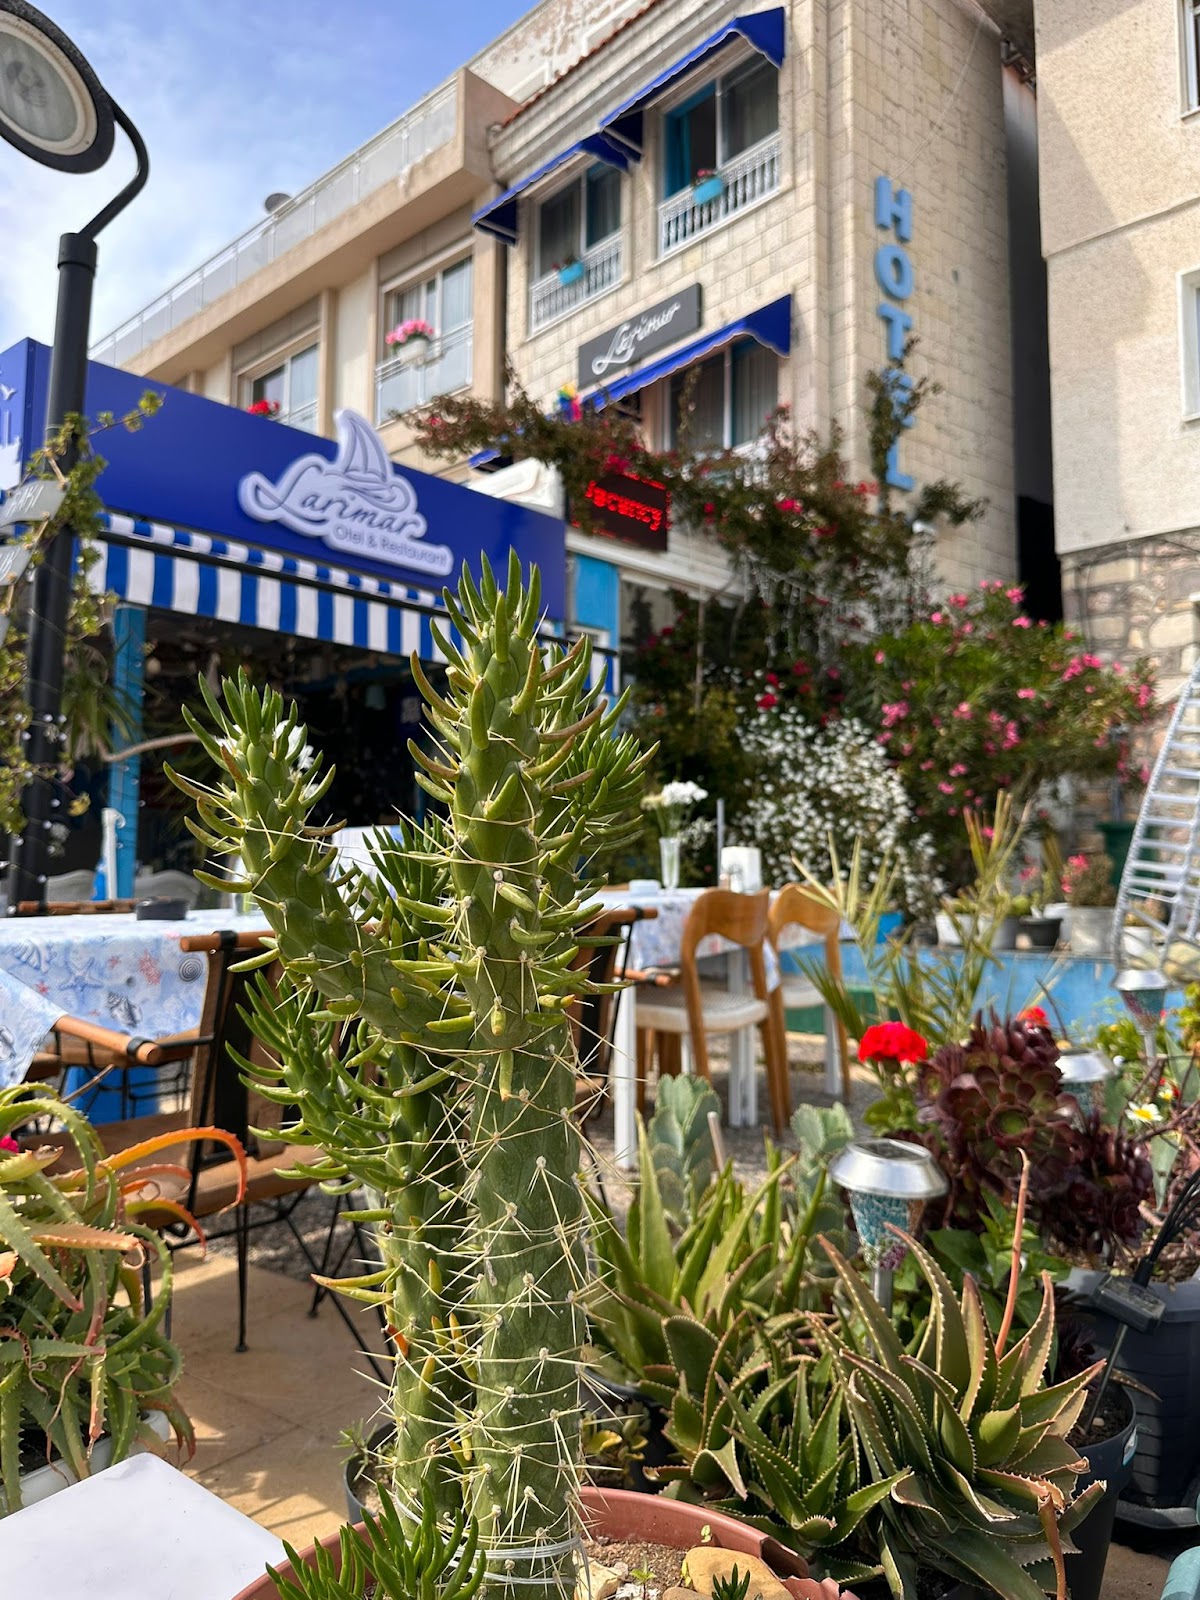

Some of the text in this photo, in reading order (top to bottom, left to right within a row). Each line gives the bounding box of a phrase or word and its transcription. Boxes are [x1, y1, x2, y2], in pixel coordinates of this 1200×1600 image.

[253, 462, 421, 535] Larimar
[332, 524, 365, 545] Otel
[380, 536, 448, 567] Restaurant
